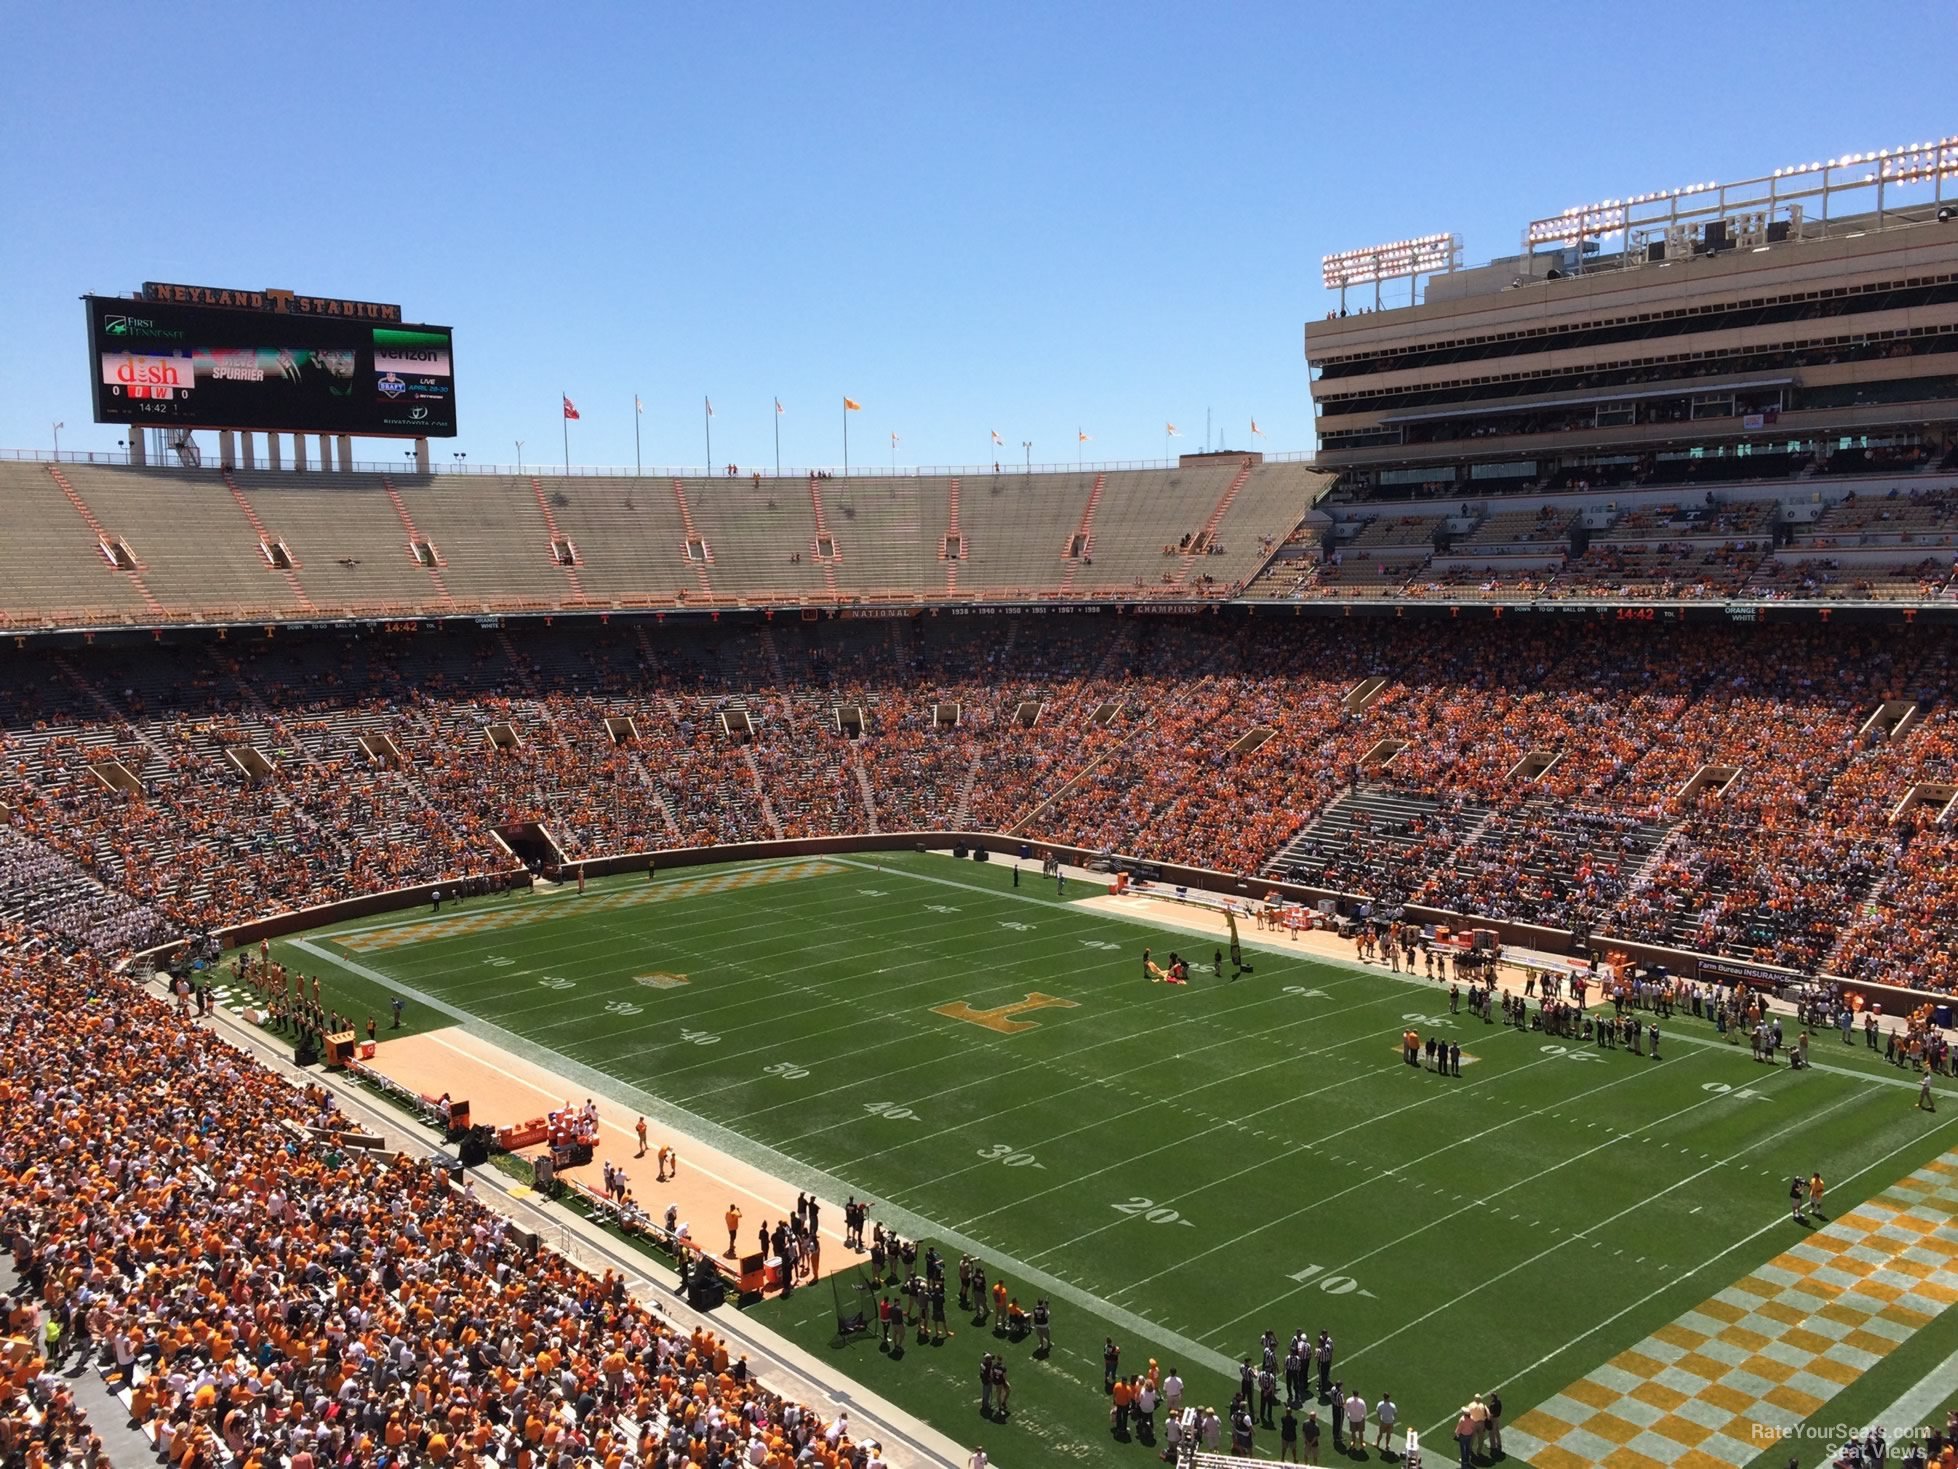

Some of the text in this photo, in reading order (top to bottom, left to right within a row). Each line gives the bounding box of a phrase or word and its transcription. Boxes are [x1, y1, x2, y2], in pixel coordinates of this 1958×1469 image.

[157, 284, 263, 307] NEYLAND
[301, 298, 397, 319] STADIUM
[128, 317, 153, 328] FIRST
[380, 349, 437, 362] verizon
[116, 354, 179, 385] dish
[213, 367, 264, 381] SPURRIER
[113, 386, 120, 396] 0
[156, 388, 168, 398] W
[182, 390, 188, 399] 0
[380, 382, 403, 392] DRAFT
[140, 404, 166, 413] 14:42
[852, 609, 909, 618] NATIONAL
[1138, 606, 1197, 614] CHAMPIONS
[1617, 608, 1654, 620] 14:42
[385, 622, 418, 632] 14:42
[482, 956, 516, 967] 10
[1699, 961, 1790, 982] Farm Bureau INSURANCE
[538, 977, 577, 990] 20
[604, 1002, 644, 1016] 30
[1402, 1013, 1454, 1027] 30
[680, 1031, 722, 1046] 40
[1540, 1045, 1601, 1061] 20
[763, 1062, 810, 1080] 50
[1701, 1082, 1761, 1098] 10
[863, 1102, 913, 1119] 40
[976, 1144, 1035, 1167] 30
[1111, 1197, 1179, 1224] 20
[1285, 1264, 1358, 1294] 10
